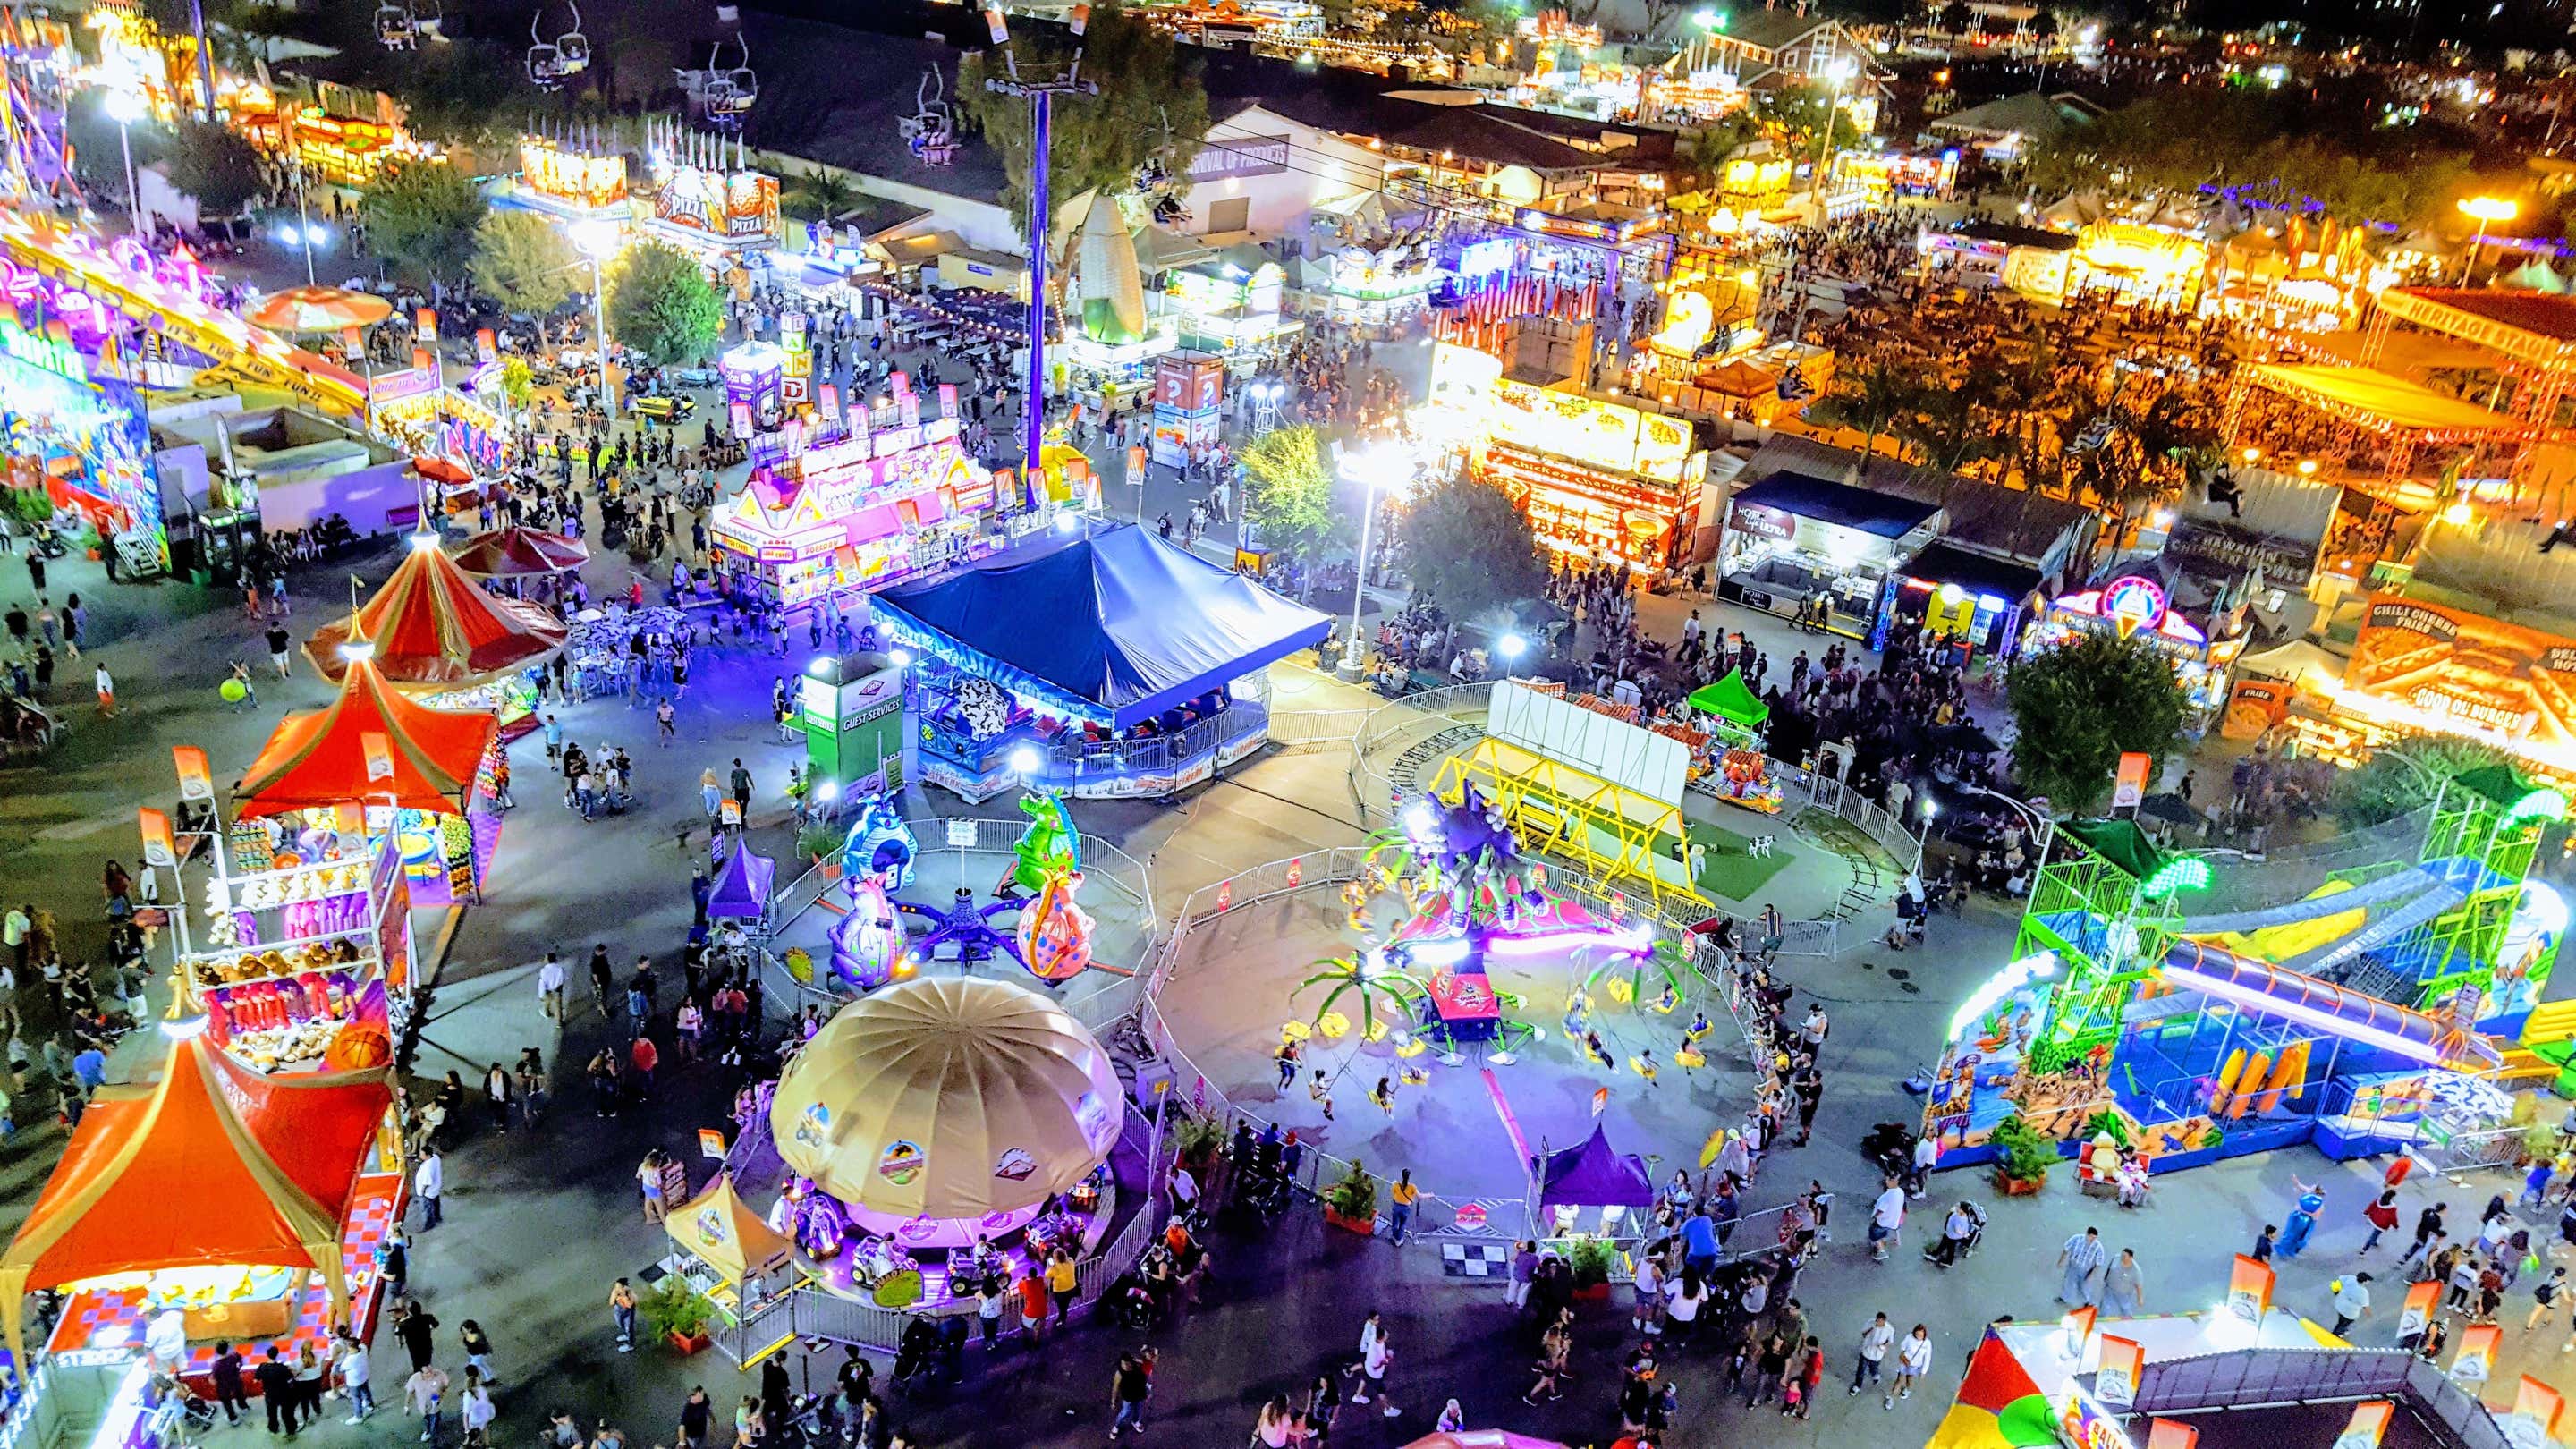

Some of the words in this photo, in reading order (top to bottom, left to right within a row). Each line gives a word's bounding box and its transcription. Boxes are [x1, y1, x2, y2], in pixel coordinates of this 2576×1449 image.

[1226, 148, 1240, 169] OF
[1241, 143, 1287, 168] PRODUCTS
[671, 193, 710, 226] PIZZA
[731, 215, 762, 235] PIZZA
[2409, 300, 2487, 337] HERITAGE
[208, 342, 236, 361] FUN
[247, 360, 274, 379] FUN
[1759, 521, 1787, 538] ULTRA
[805, 540, 839, 555] POPCORN
[2203, 536, 2277, 563] HAWAIIAN
[2373, 605, 2410, 617] CHILI
[2411, 608, 2457, 636] CHEESE
[2395, 616, 2431, 634] FRIES
[806, 714, 818, 726] GUEST
[843, 711, 868, 732] GUEST
[868, 699, 900, 721] SERVICES
[2416, 688, 2452, 711] GOOD
[2470, 704, 2522, 730] BURGER
